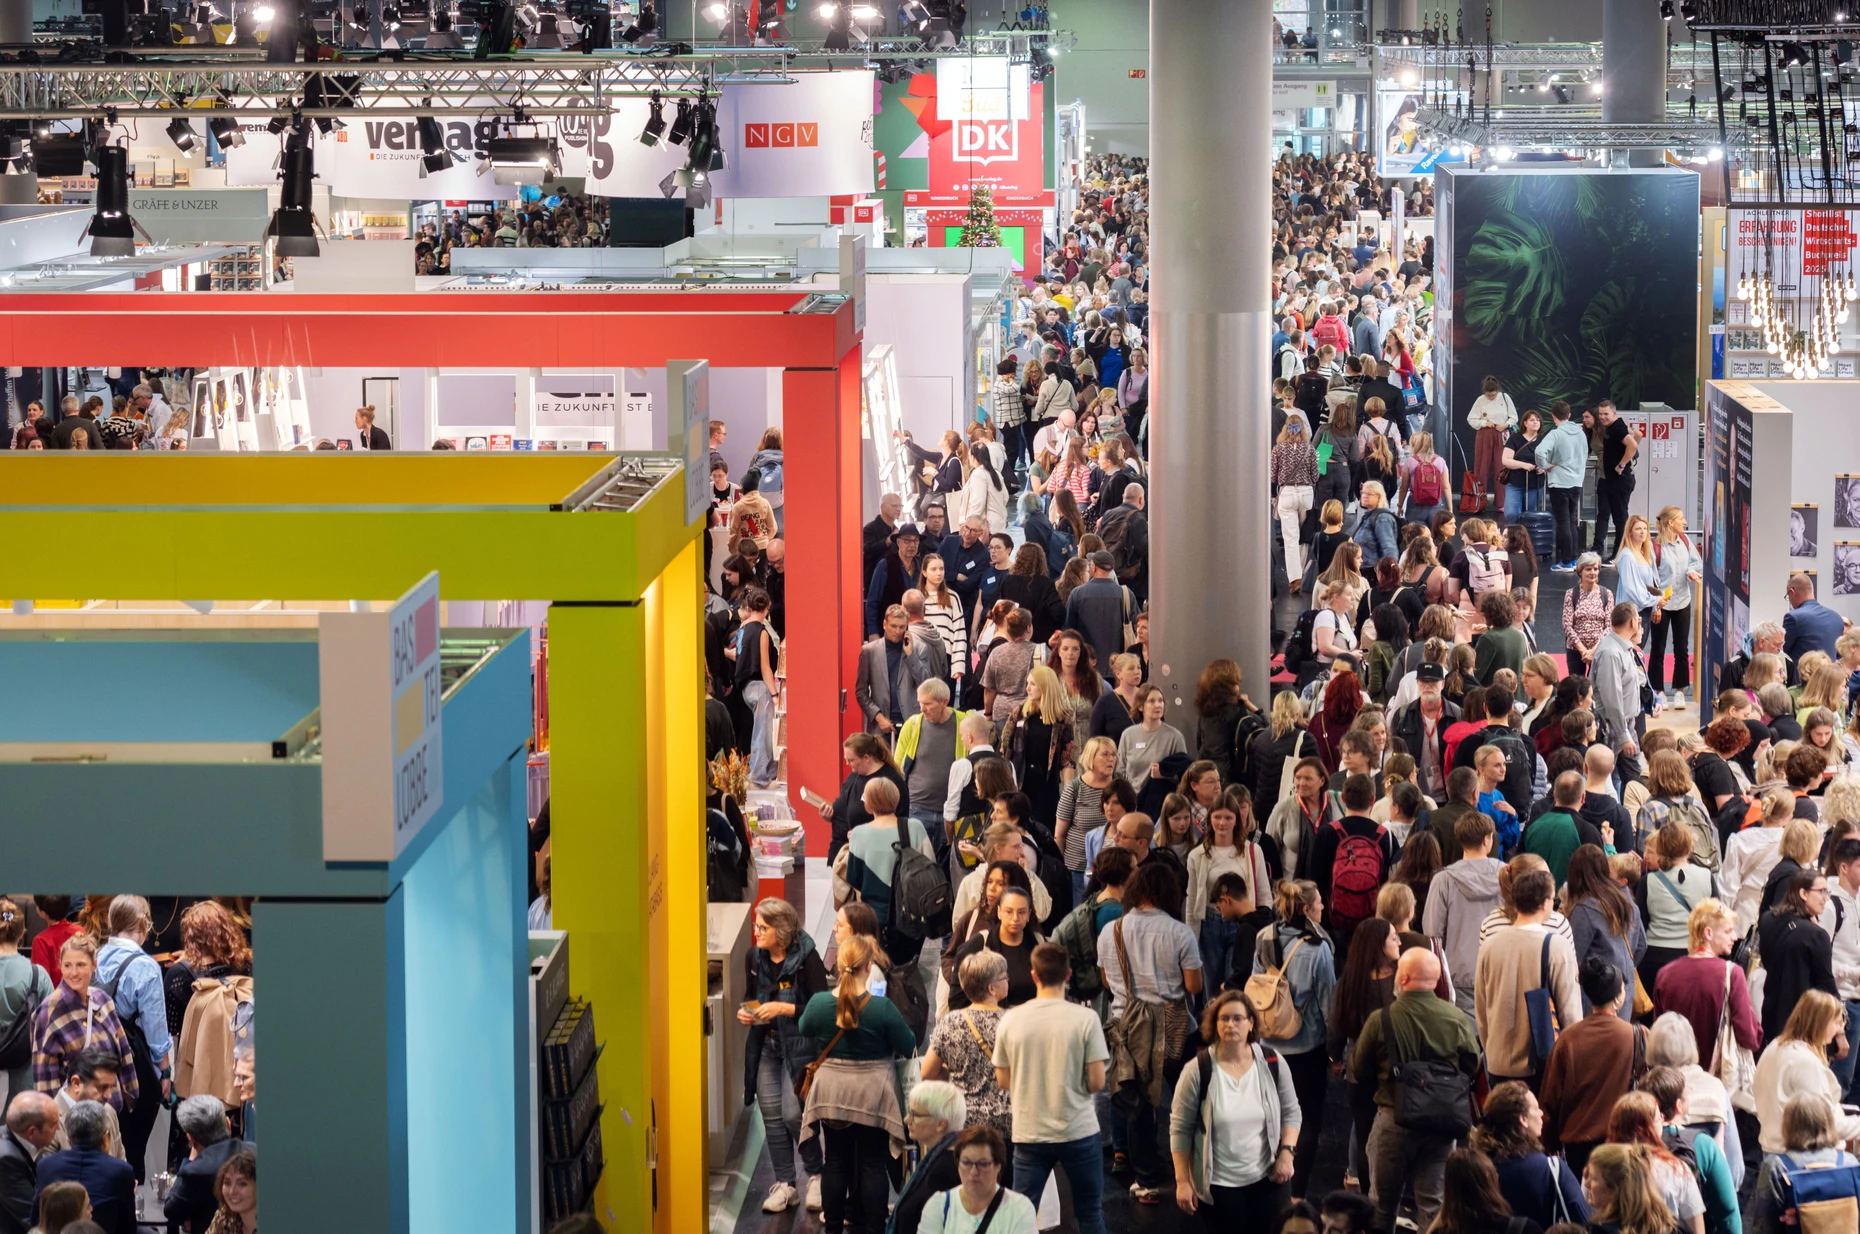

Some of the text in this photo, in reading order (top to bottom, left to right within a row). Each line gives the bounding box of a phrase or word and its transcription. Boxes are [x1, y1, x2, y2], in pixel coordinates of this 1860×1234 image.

[750, 126, 814, 143] NGV
[962, 125, 1010, 150] DK
[133, 198, 218, 210] GRÄFE & UNZER
[1806, 210, 1843, 218] Shortlist
[1739, 220, 1797, 233] ERFAHRUNG
[1806, 223, 1848, 231] Deutscher
[1805, 251, 1847, 260] Buchpreis
[1805, 265, 1827, 273] 2025
[394, 613, 414, 687] BAS
[424, 663, 439, 728] TEI
